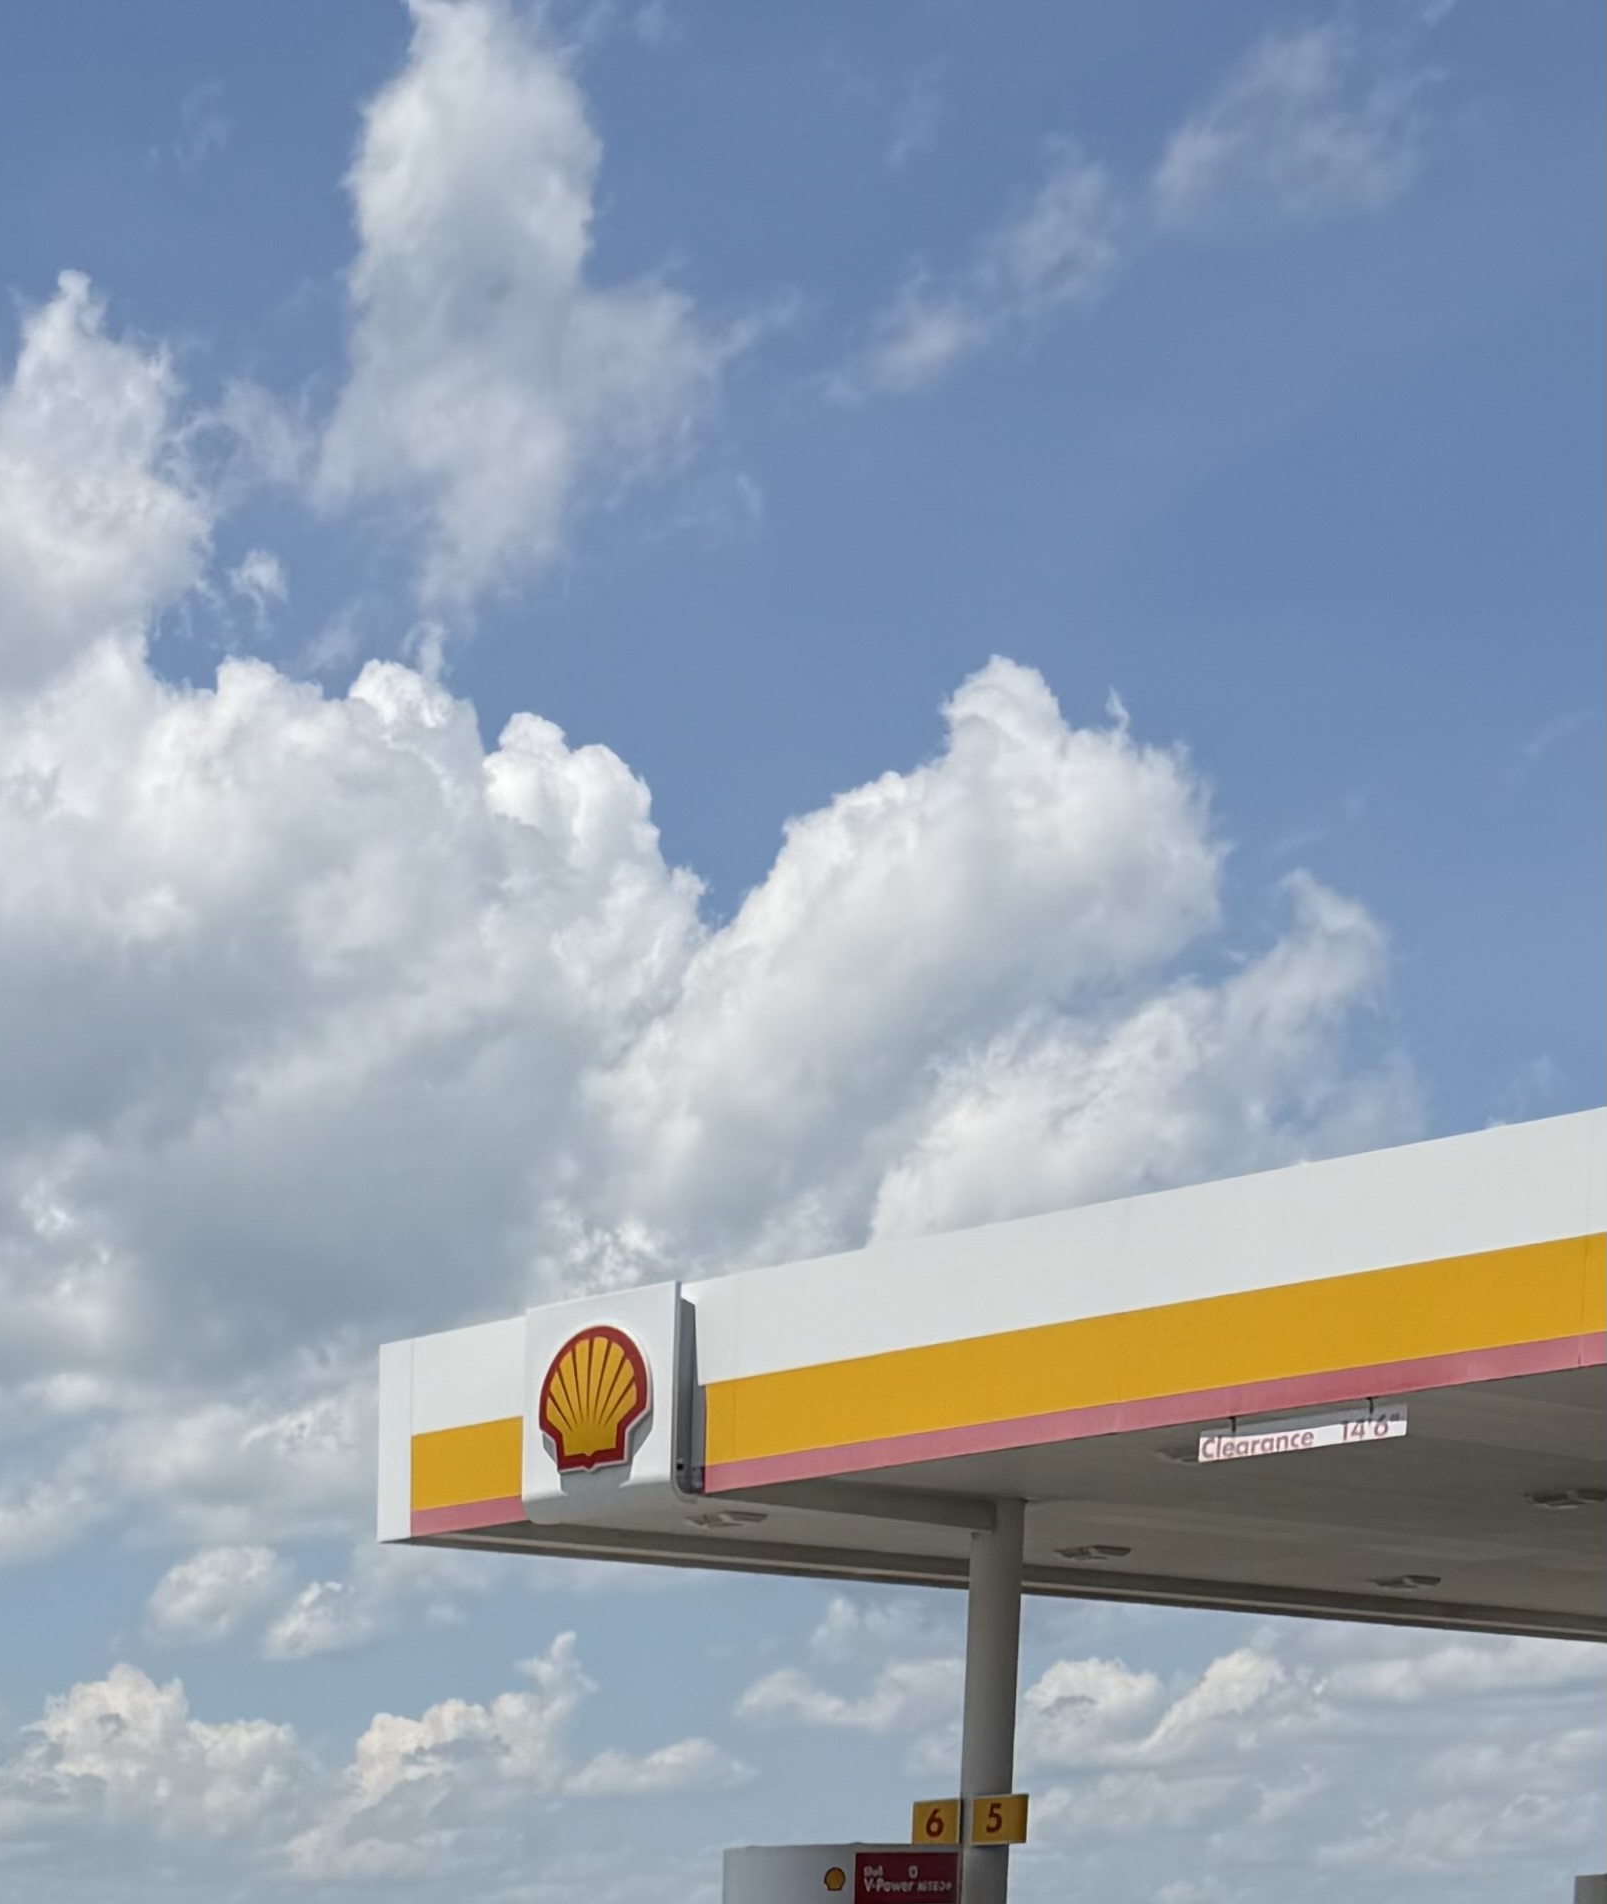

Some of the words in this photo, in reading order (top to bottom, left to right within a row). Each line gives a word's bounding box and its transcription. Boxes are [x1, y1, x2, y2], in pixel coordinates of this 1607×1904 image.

[1201, 1430, 1315, 1459] Clearance
[925, 1808, 944, 1838] 6
[985, 1802, 1003, 1834] 5
[863, 1878, 913, 1893] V-Power
